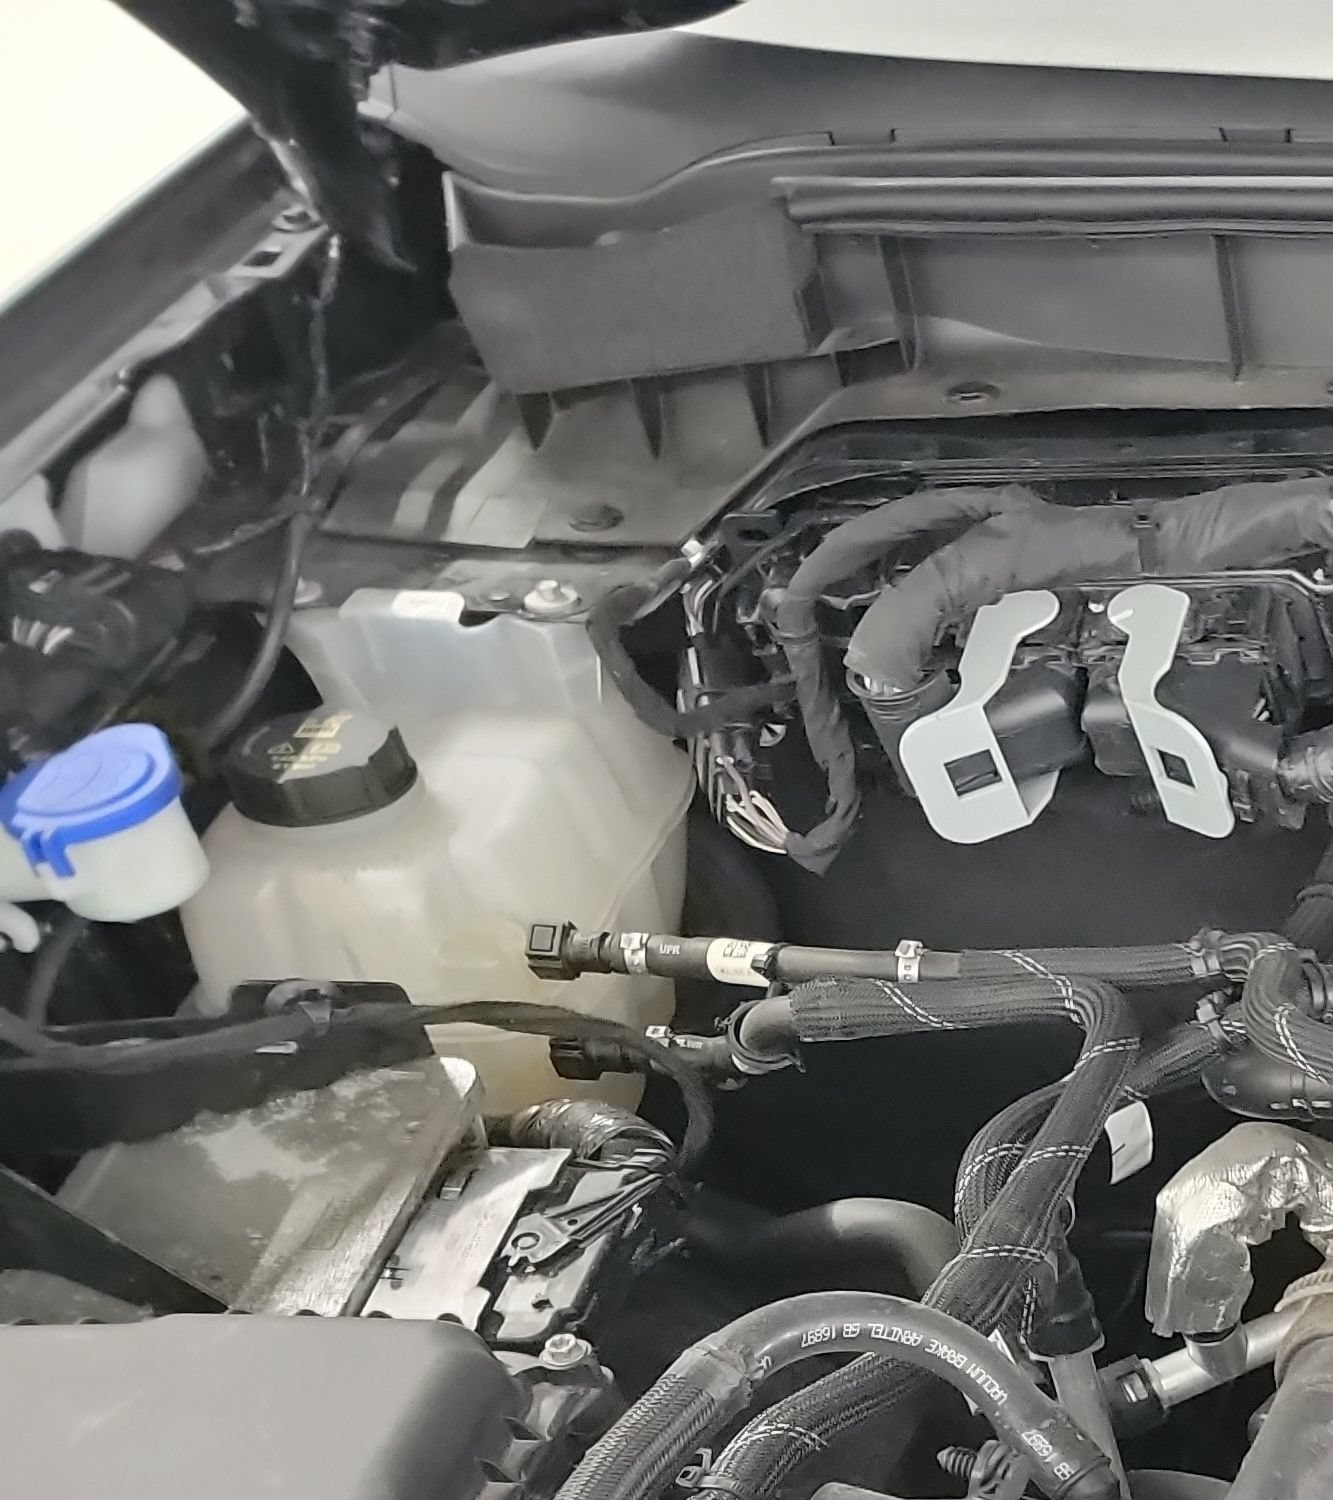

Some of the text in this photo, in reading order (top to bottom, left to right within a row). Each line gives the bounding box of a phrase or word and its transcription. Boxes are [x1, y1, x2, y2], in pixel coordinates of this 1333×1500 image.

[659, 943, 680, 955] UPR
[801, 1324, 836, 1347] 16897
[867, 1323, 923, 1347] ARNITEL
[924, 1338, 967, 1369] BRAKE
[965, 1363, 1008, 1405] VACUUM
